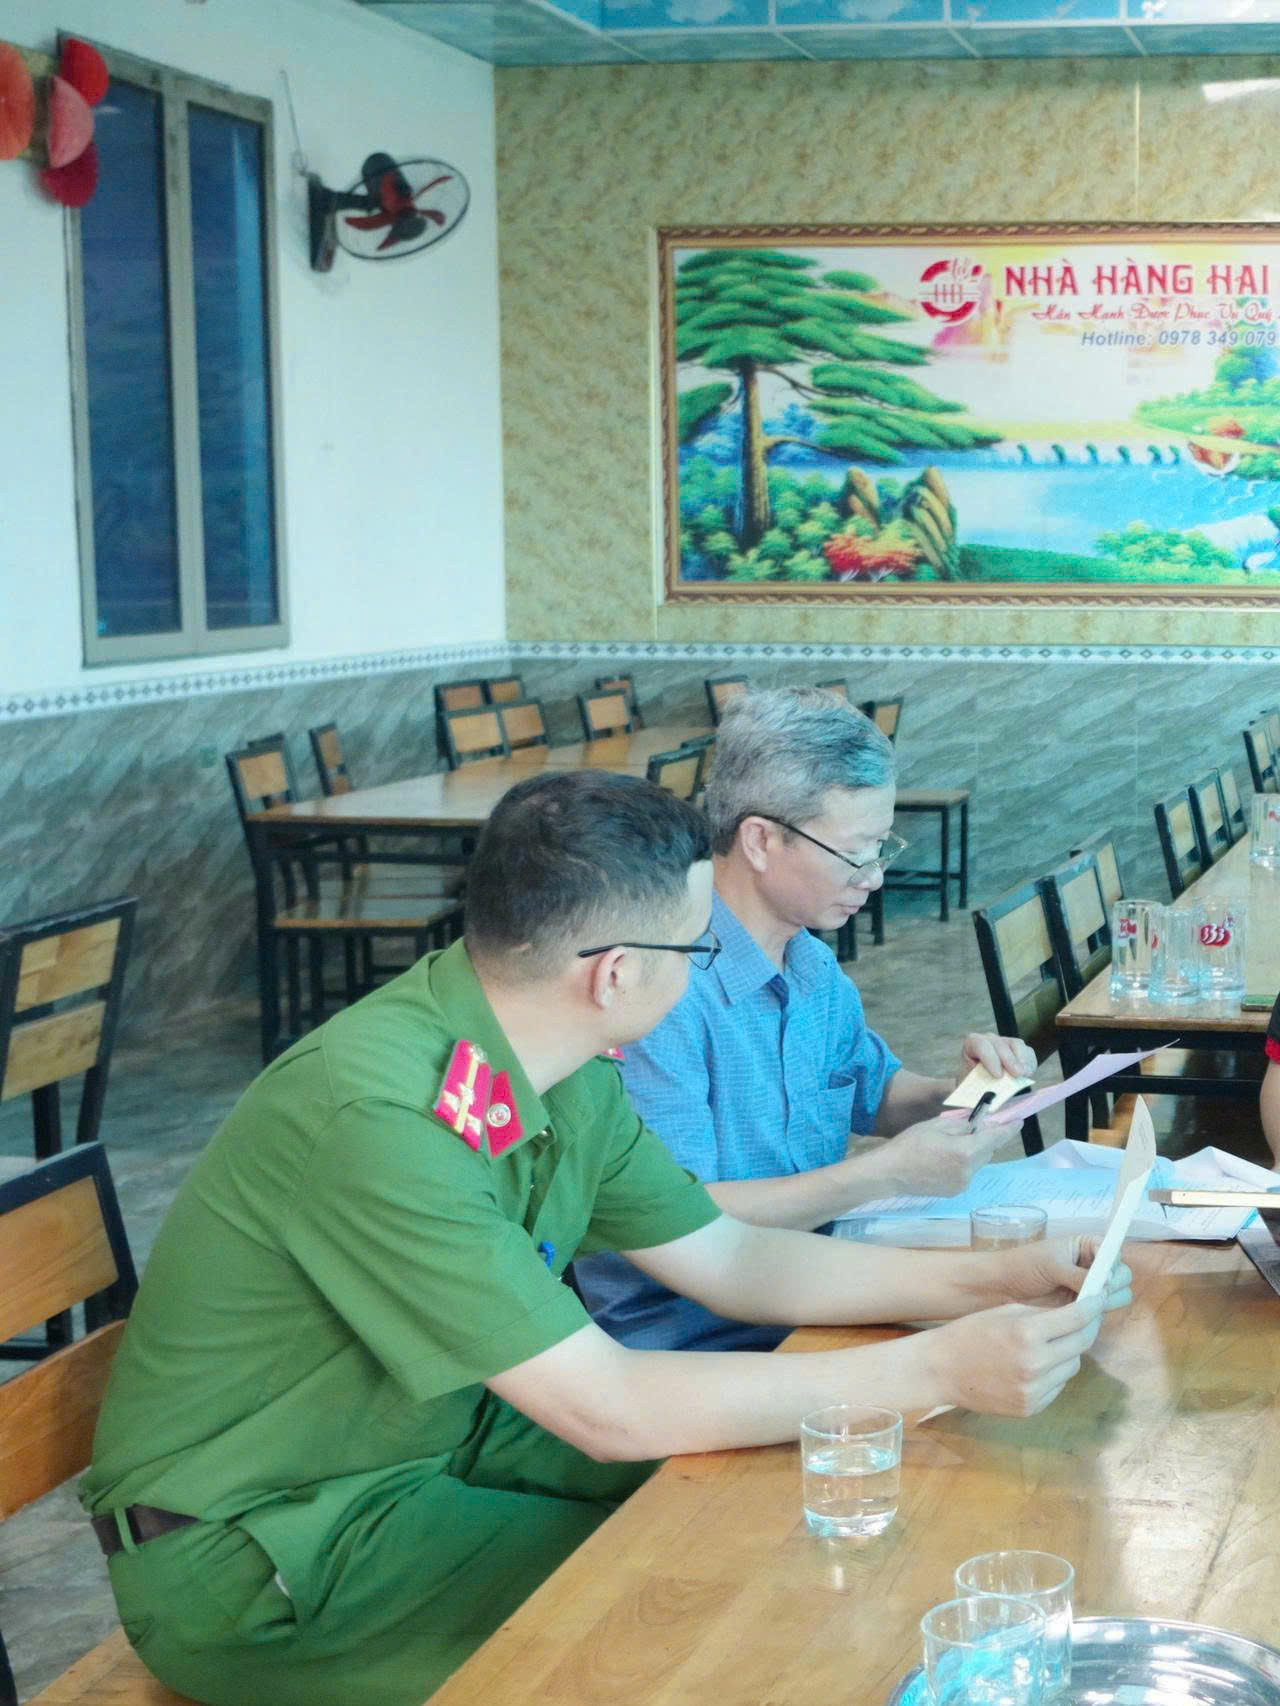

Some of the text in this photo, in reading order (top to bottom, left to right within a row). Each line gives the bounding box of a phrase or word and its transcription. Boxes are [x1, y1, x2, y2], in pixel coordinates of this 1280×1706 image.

[1005, 258, 1078, 296] NHÀ
[1092, 257, 1193, 295] HÀNG
[1206, 264, 1269, 295] HAI
[1081, 330, 1276, 346] Hotline: 0978 349 079
